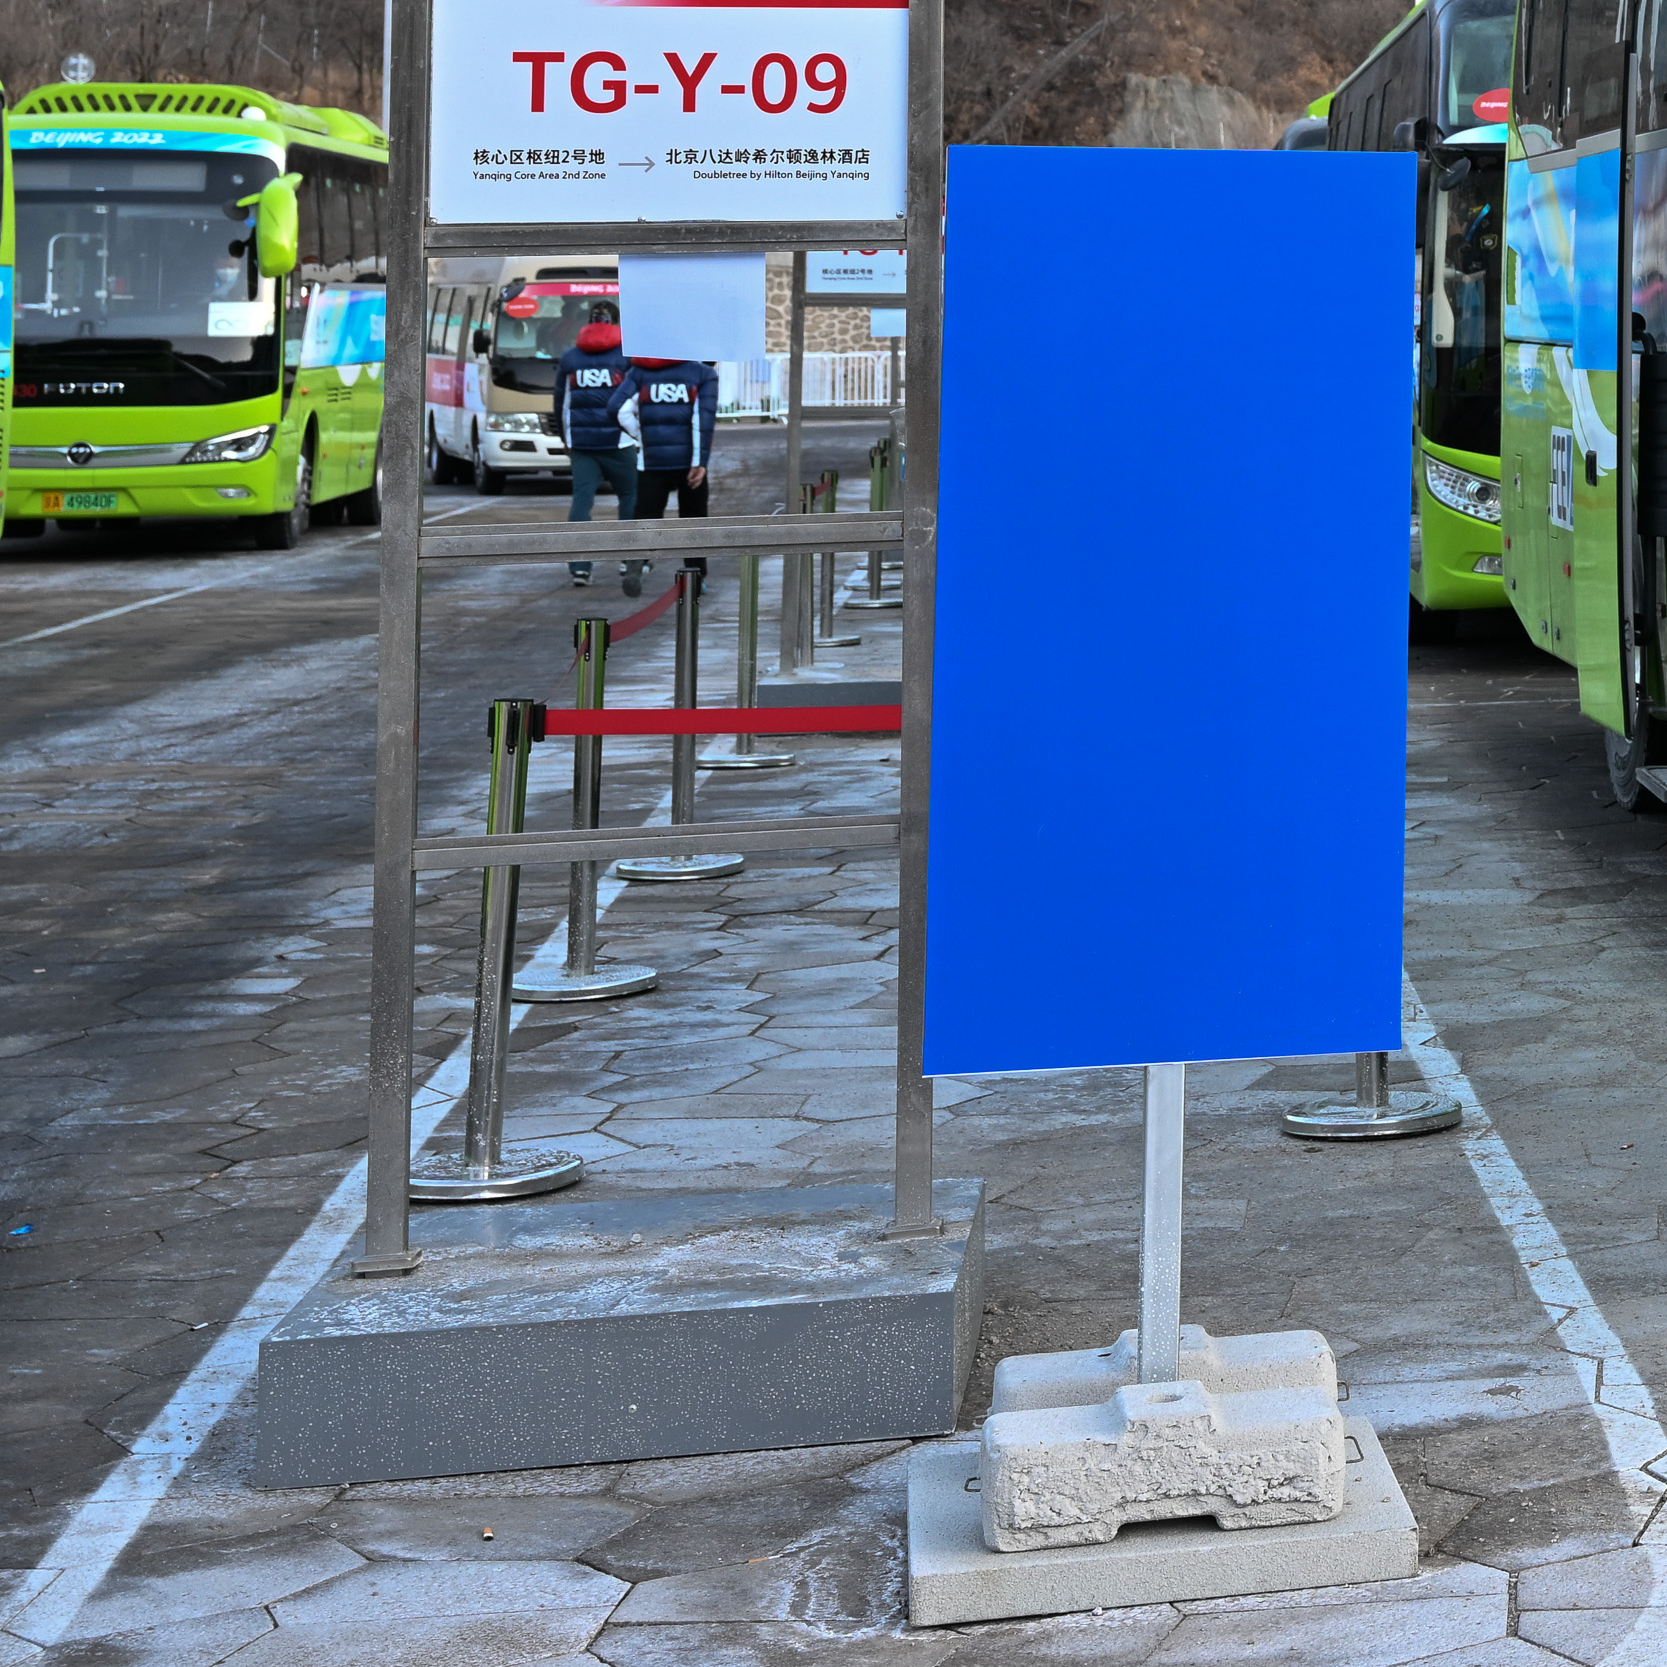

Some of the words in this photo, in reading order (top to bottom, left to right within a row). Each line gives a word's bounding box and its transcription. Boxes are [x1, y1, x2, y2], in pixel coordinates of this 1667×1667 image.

[512, 51, 848, 114] TG-Y-09
[30, 131, 104, 148] BEIJING
[110, 132, 166, 144] 2022
[473, 149, 606, 165] 核心区枢纽2号地
[665, 148, 870, 165] 北京八达岭希尔顿逸林酒店
[473, 171, 512, 182] Yanqing
[514, 171, 536, 180] Core
[538, 171, 560, 180] Area
[562, 171, 580, 180] 2nd
[582, 171, 606, 180] Zone
[693, 170, 747, 179] Doubletree
[750, 170, 761, 181] by
[764, 170, 793, 179] Hilton
[795, 170, 828, 181] Beijing
[830, 170, 870, 181] Yanqing
[576, 368, 612, 388] USA
[43, 382, 125, 394] FOTON
[649, 383, 689, 404] USA
